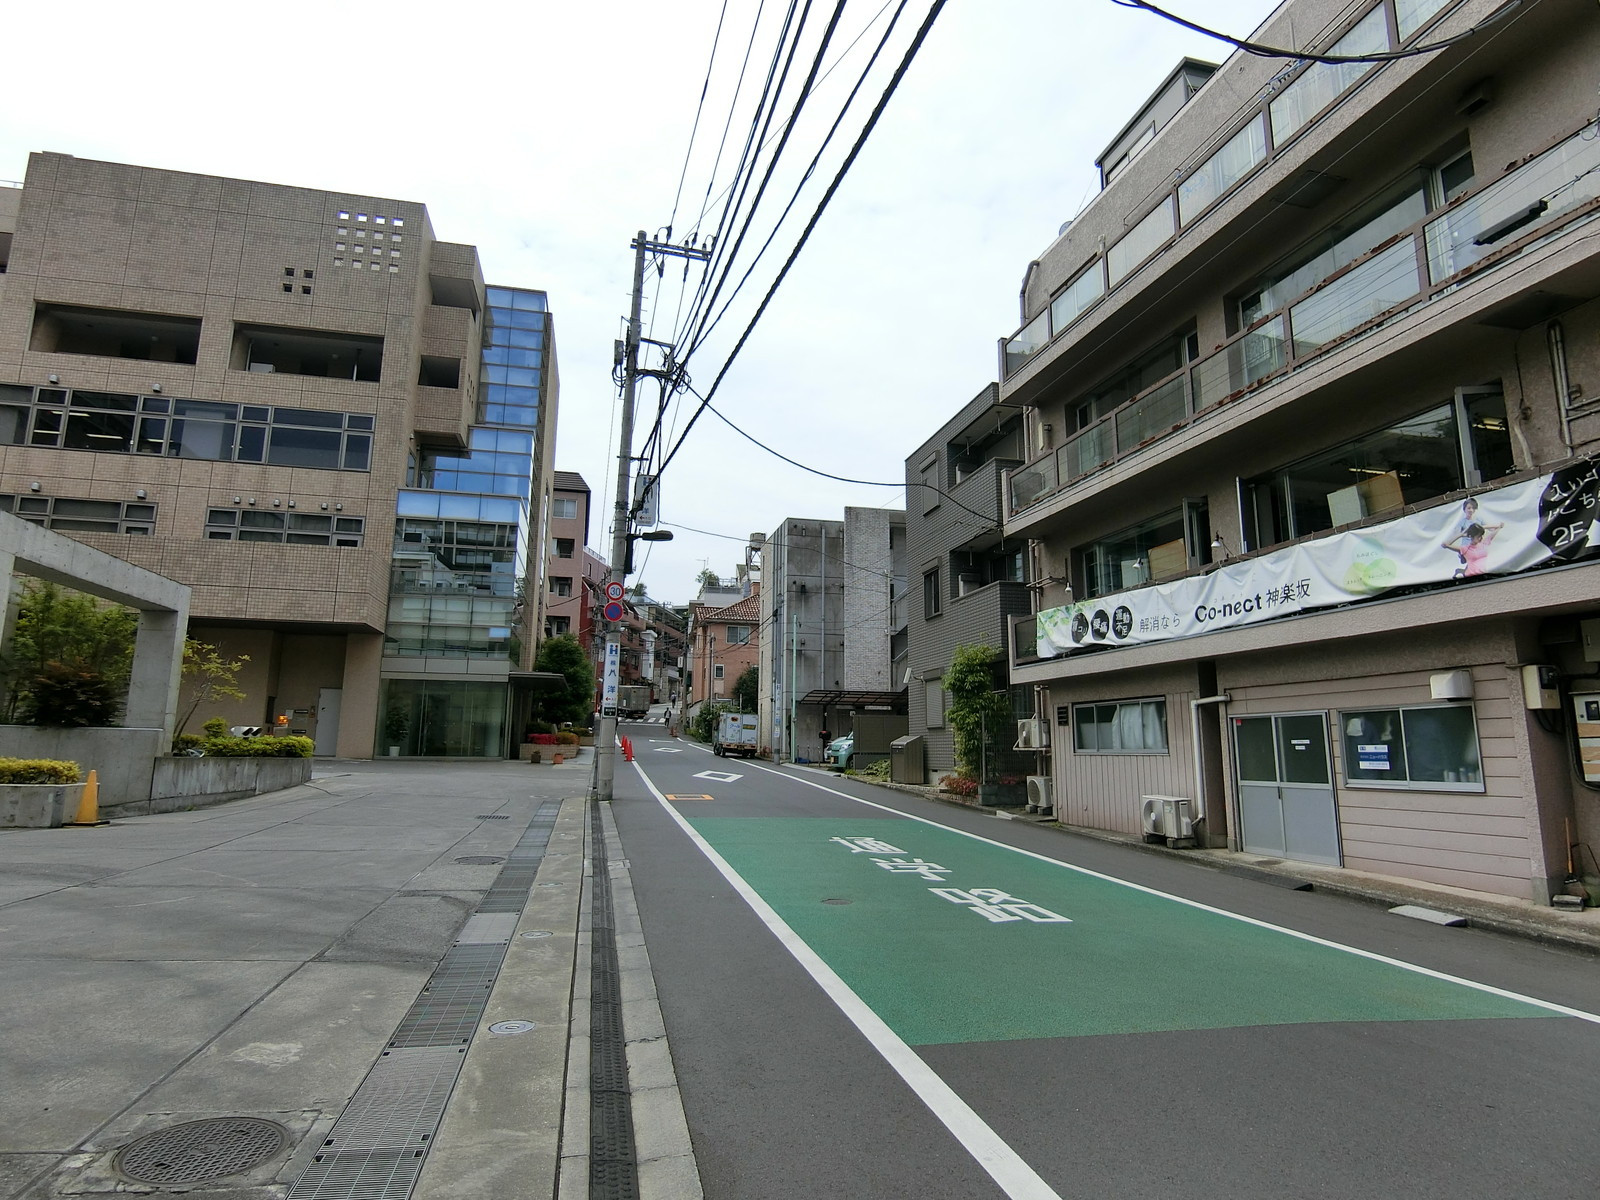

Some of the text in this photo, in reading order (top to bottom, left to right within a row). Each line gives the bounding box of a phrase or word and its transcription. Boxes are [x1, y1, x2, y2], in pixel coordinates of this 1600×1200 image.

[1552, 521, 1584, 547] 2F
[610, 587, 621, 597] 30
[1139, 578, 1311, 633] 解消なら Co-nect 神楽坂
[828, 836, 1073, 923] 通学路
